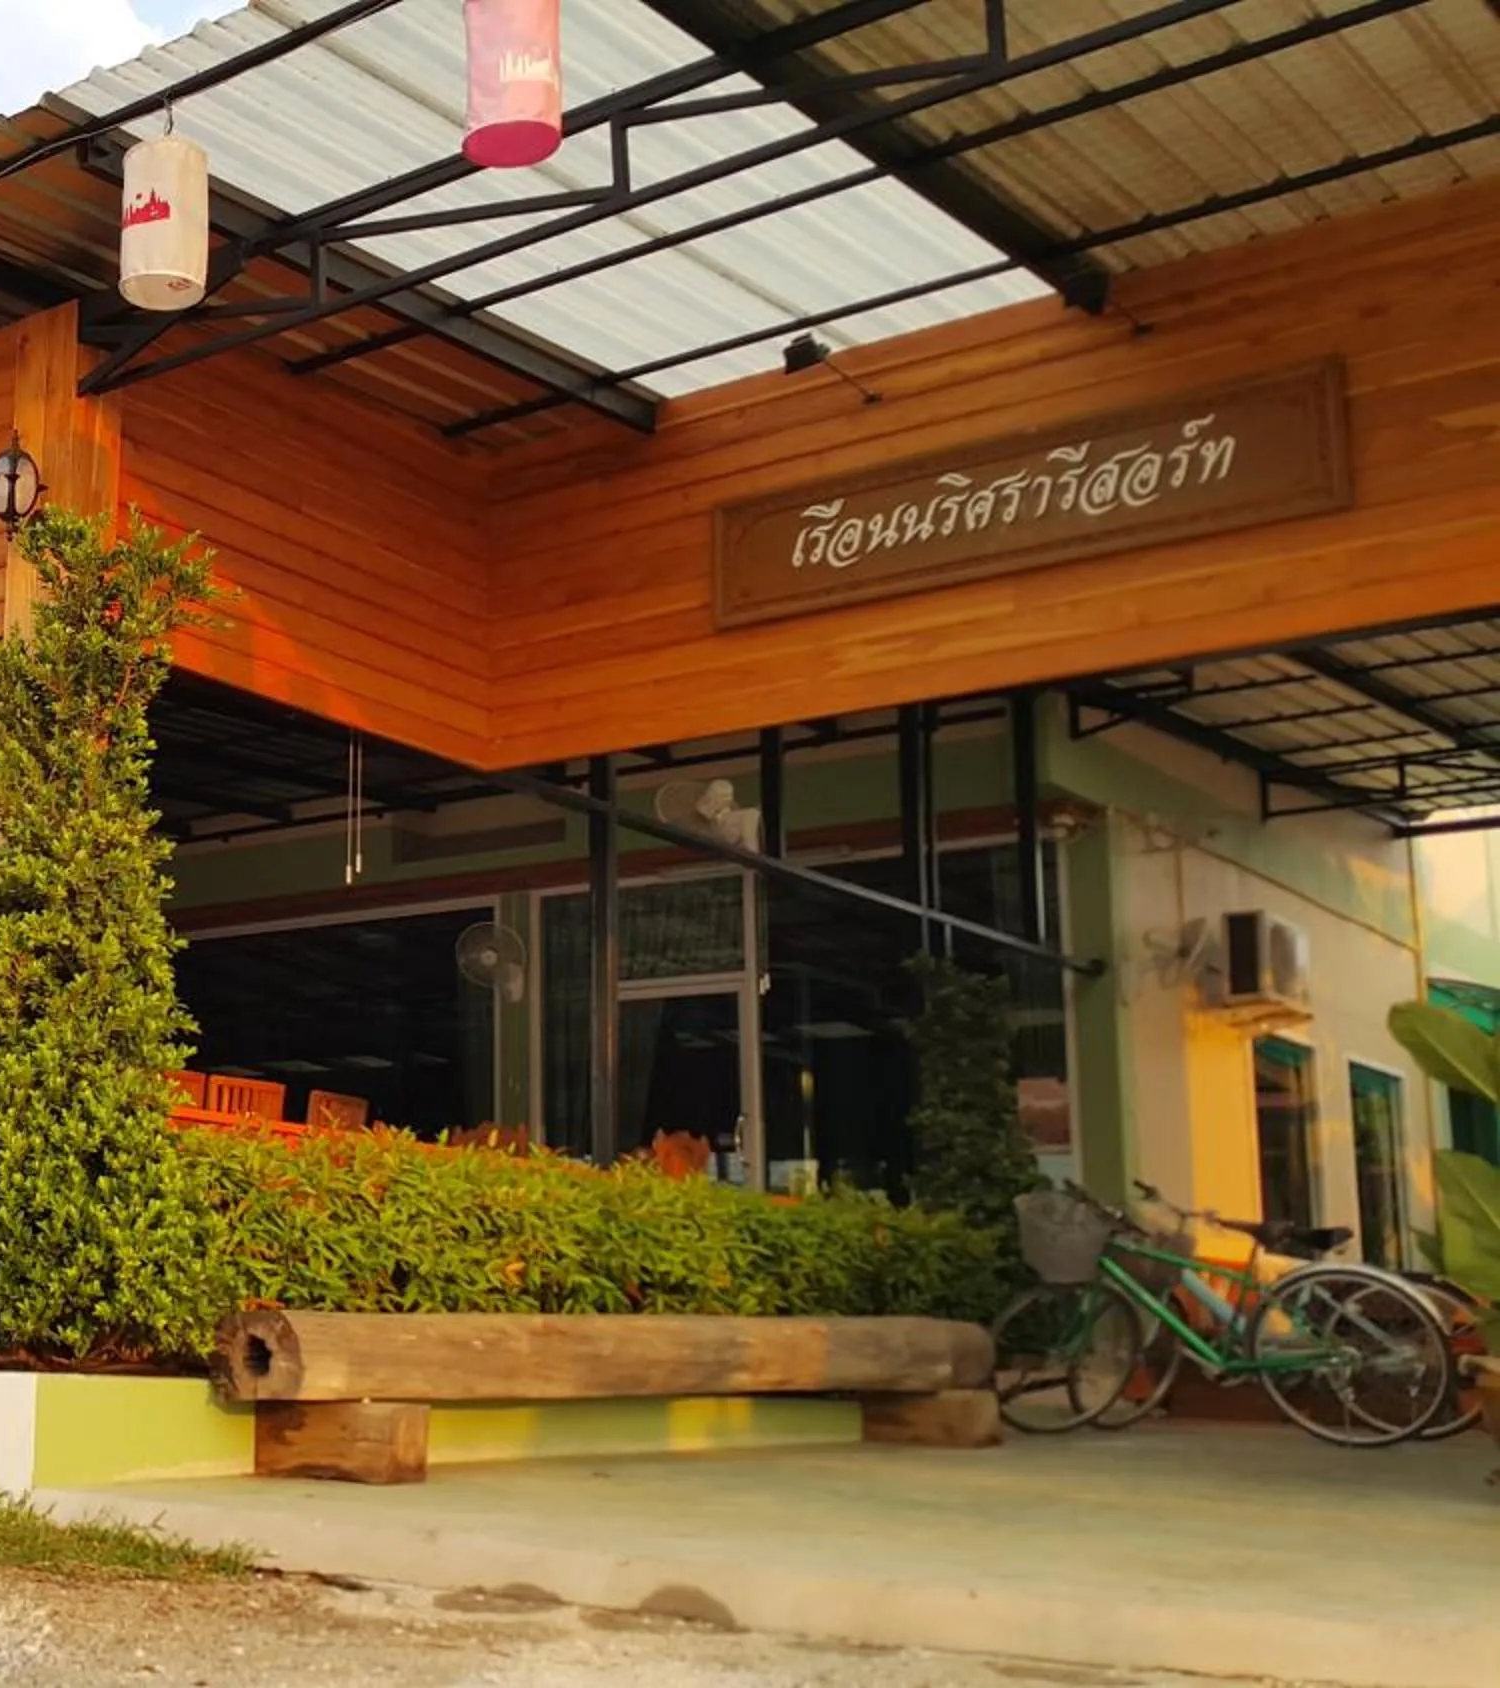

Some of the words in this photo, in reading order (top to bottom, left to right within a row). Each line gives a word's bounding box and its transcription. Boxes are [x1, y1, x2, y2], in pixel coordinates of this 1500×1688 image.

[791, 414, 1236, 568] เรือนนริศรารีสอร์ท
